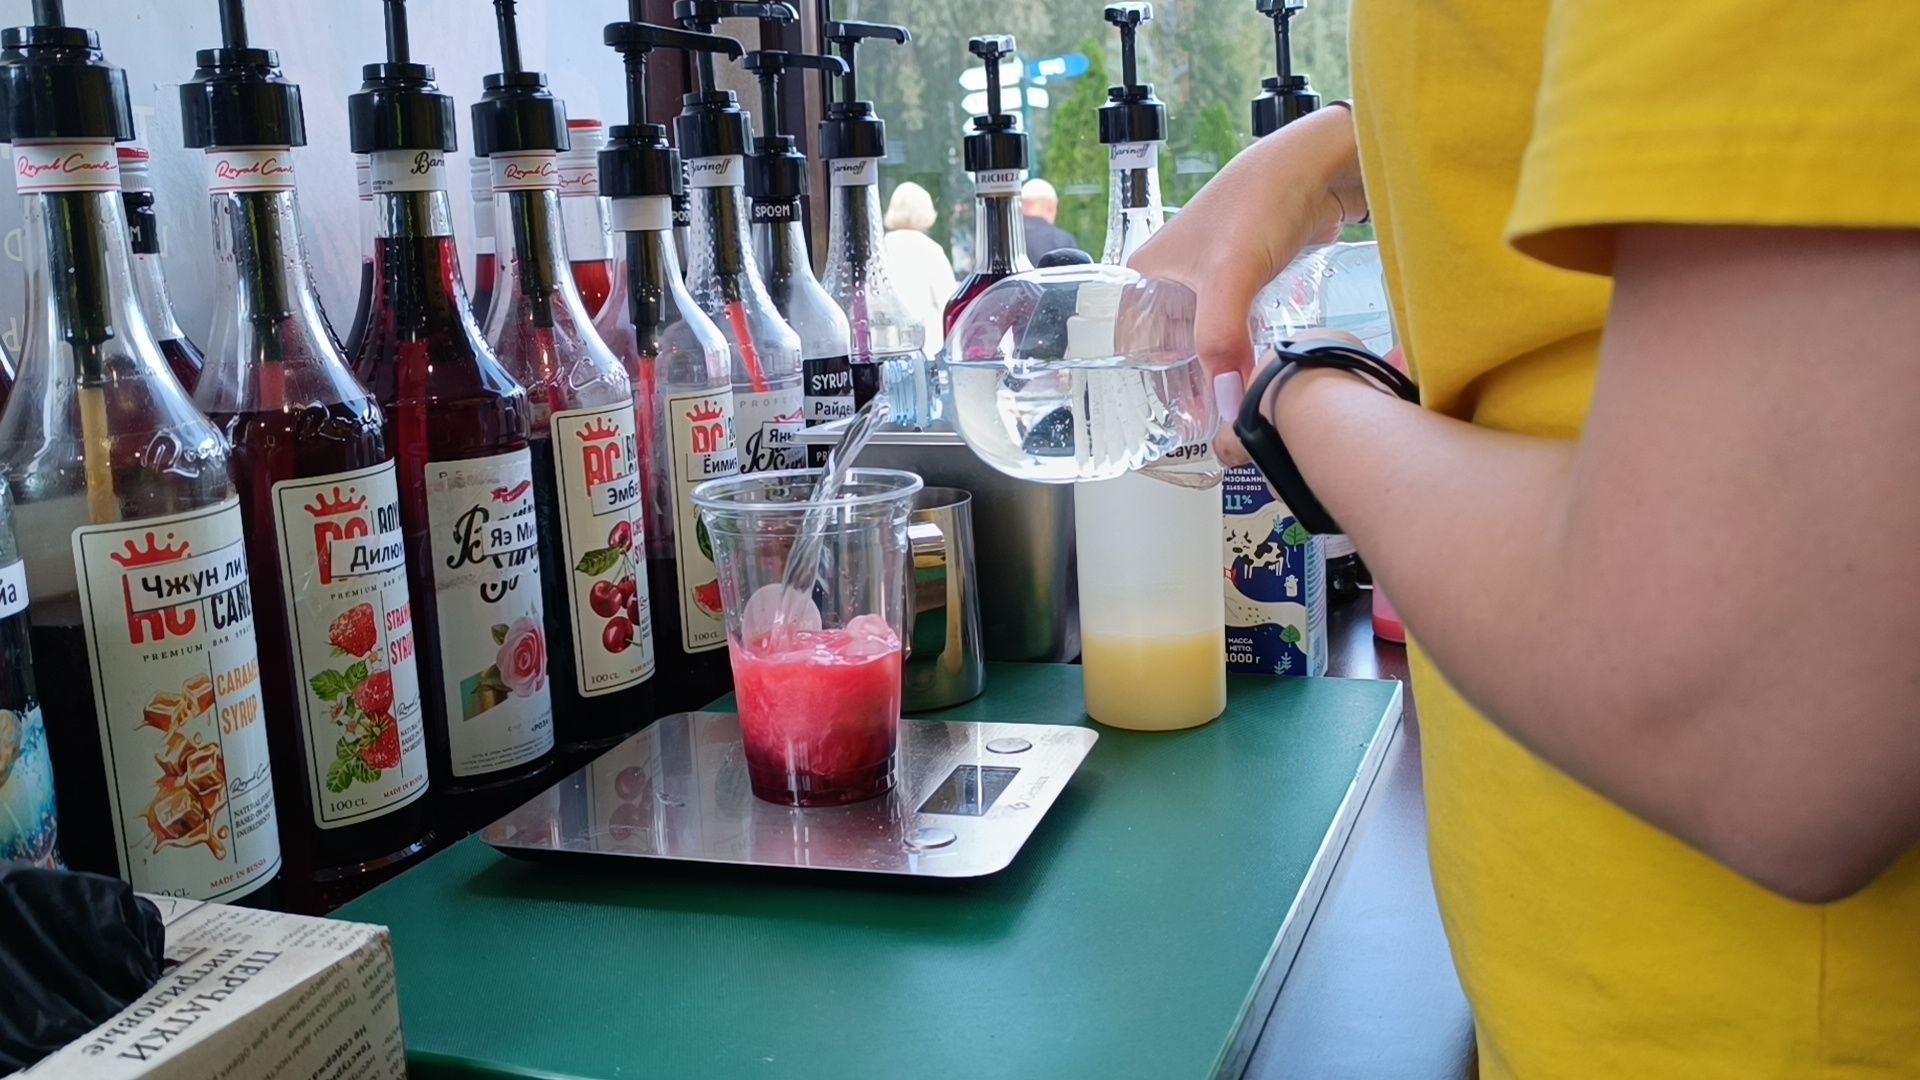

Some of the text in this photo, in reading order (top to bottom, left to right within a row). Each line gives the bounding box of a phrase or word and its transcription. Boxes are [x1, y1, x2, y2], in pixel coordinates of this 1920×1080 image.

[18, 153, 117, 178] Royal Cane
[215, 160, 260, 180] Royal
[755, 204, 790, 218] SPOOM
[812, 371, 848, 390] SYRUP
[815, 401, 852, 418] Райде
[607, 480, 639, 505] Эмбе
[1225, 494, 1253, 510] 11%
[378, 501, 401, 534] ROY
[490, 521, 535, 548] Яэ Ми
[142, 566, 219, 599] Чжун
[224, 557, 243, 581] ли
[331, 585, 377, 600] PREMIUM
[143, 643, 203, 662] PREMIUM
[213, 635, 230, 647] BAR
[694, 632, 709, 641] 100
[591, 672, 609, 685] 100
[221, 693, 258, 735] SYRUP
[330, 800, 353, 813] 100
[210, 874, 234, 889] MADE
[236, 868, 245, 879] IN
[81, 948, 244, 1056] нитриловые
[117, 950, 284, 1061] ПЕРЧАТКИ
[313, 993, 358, 1038] Перчатки
[353, 1024, 367, 1040] Не
[263, 1036, 312, 1080] диагности
[307, 1038, 353, 1080] содержа
